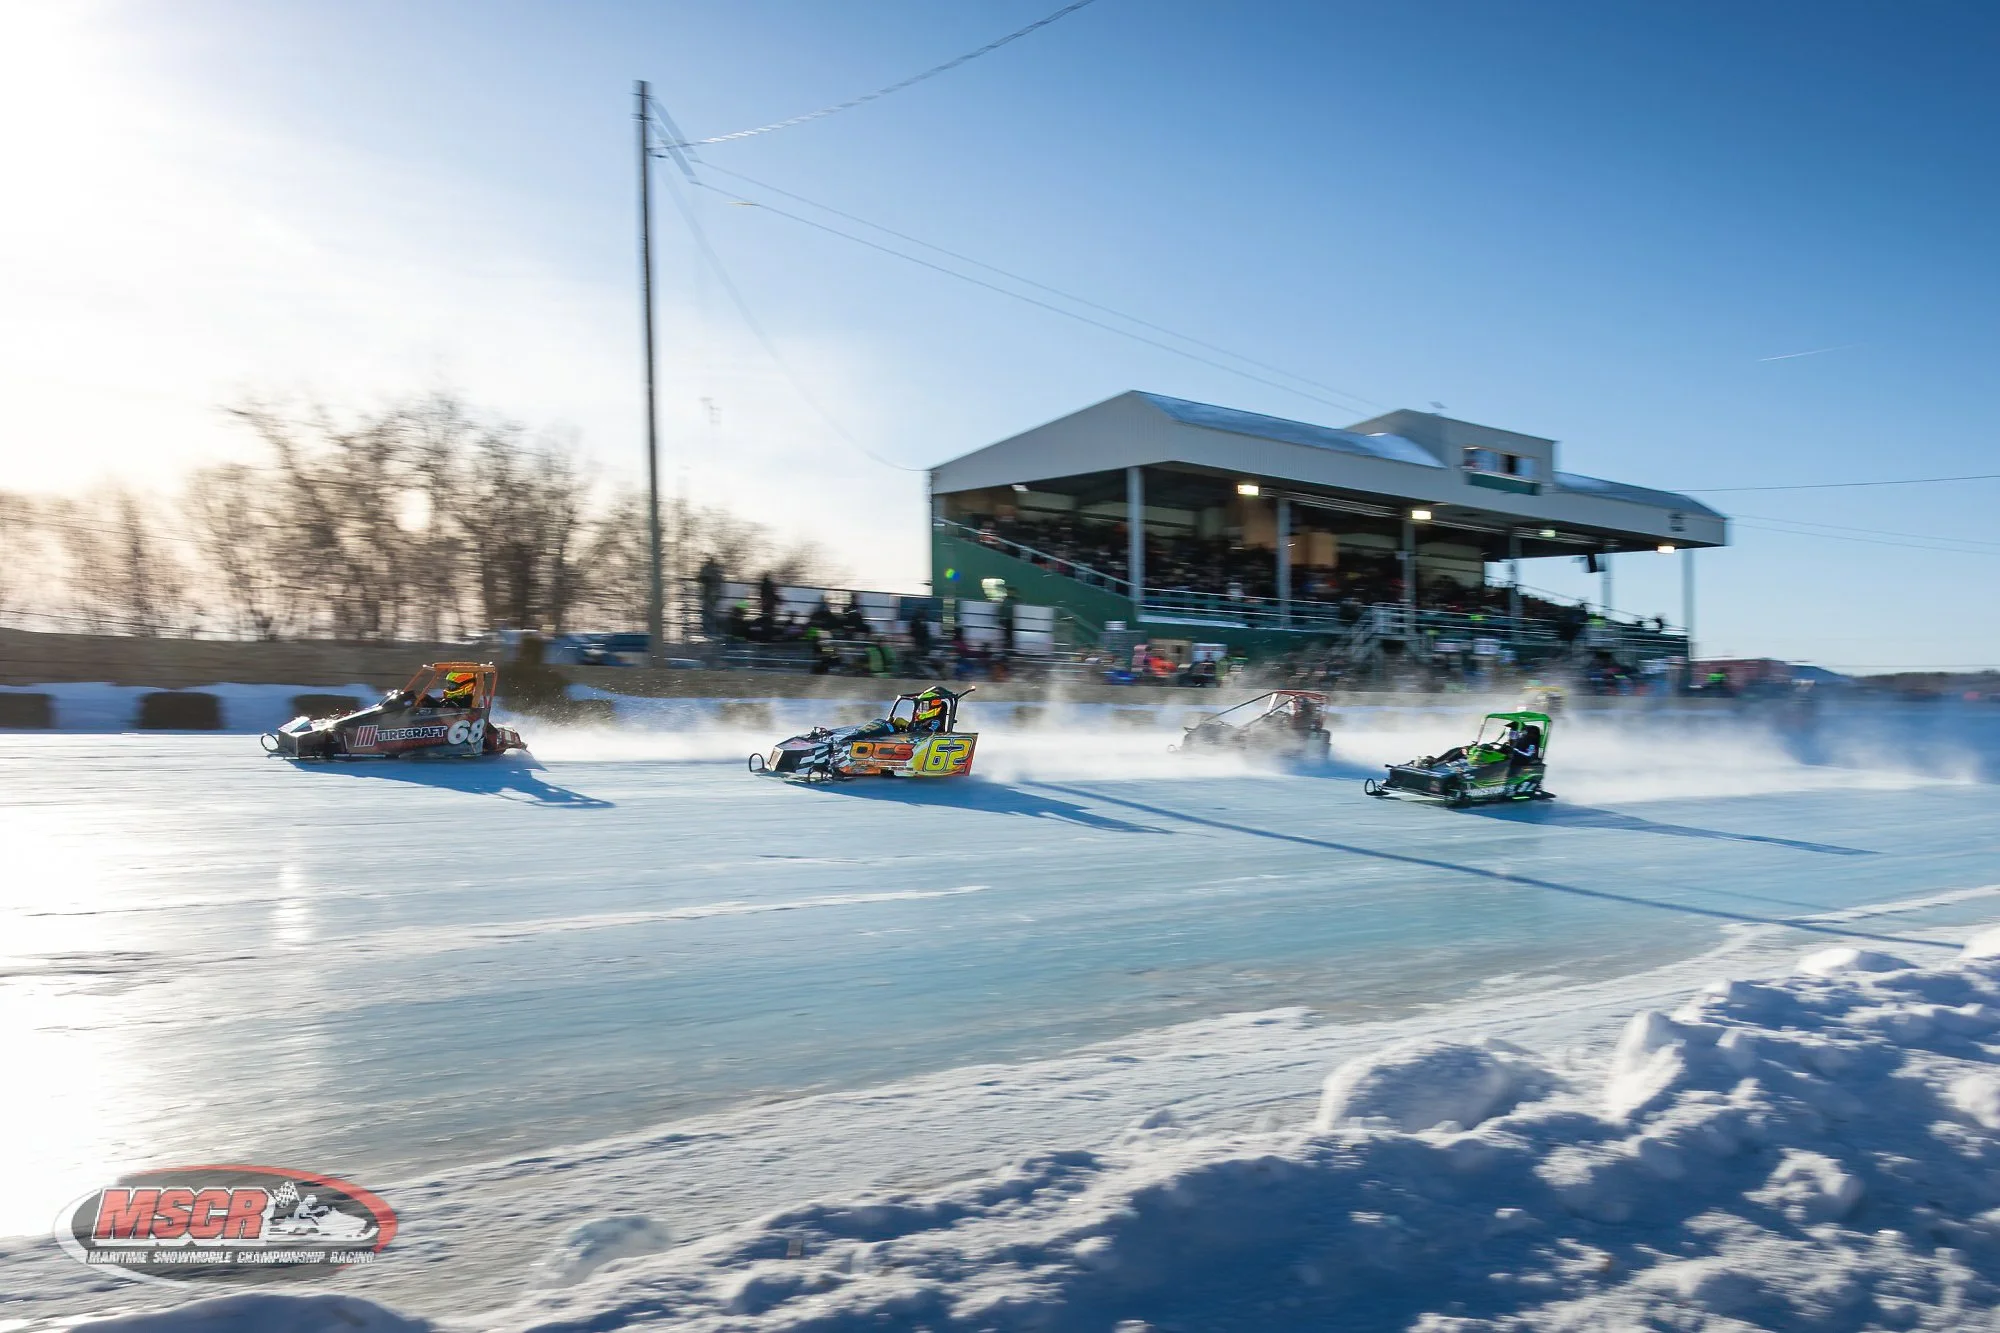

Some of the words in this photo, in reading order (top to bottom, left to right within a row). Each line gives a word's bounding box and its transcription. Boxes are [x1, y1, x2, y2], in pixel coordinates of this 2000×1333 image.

[377, 726, 447, 741] TIRECRAFT
[448, 718, 485, 745] 68
[850, 742, 914, 760] OCS
[923, 737, 973, 772] 62
